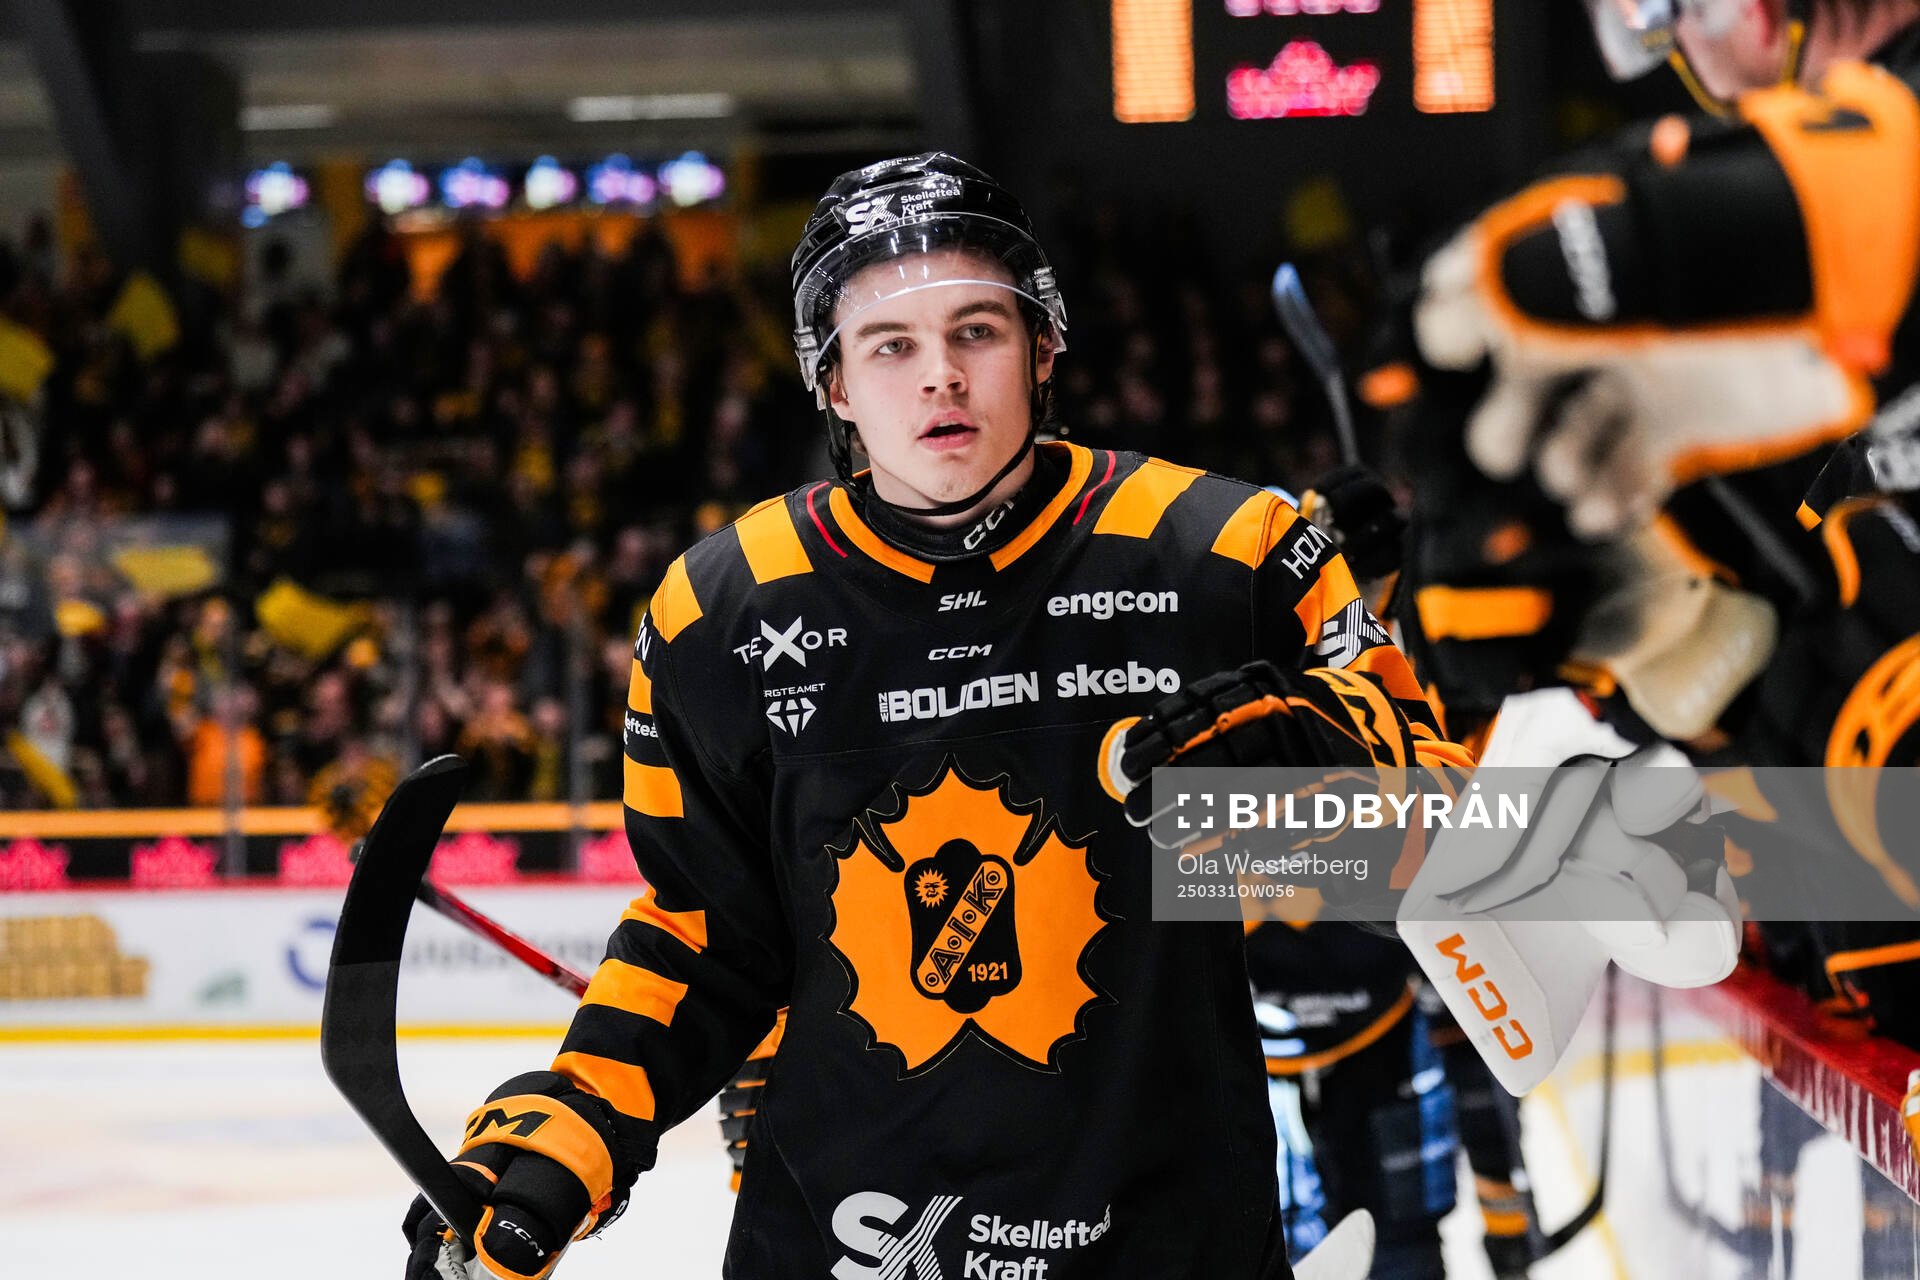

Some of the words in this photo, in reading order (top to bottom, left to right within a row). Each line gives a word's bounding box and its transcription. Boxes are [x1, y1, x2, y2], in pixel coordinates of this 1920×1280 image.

[901, 186, 961, 204] Skellefteå
[902, 200, 933, 215] Kraft
[963, 500, 1014, 550] CC
[937, 590, 987, 612] SHL
[1047, 590, 1179, 620] engcon
[733, 615, 848, 672] TEXOR
[927, 644, 993, 661] CCM
[1057, 661, 1181, 698] skebo
[878, 691, 889, 723] NEW
[968, 961, 1008, 983] 1921
[1435, 933, 1533, 1061] CCM
[968, 1203, 1111, 1250] Skellefteå
[963, 1250, 1049, 1280] Kraft
